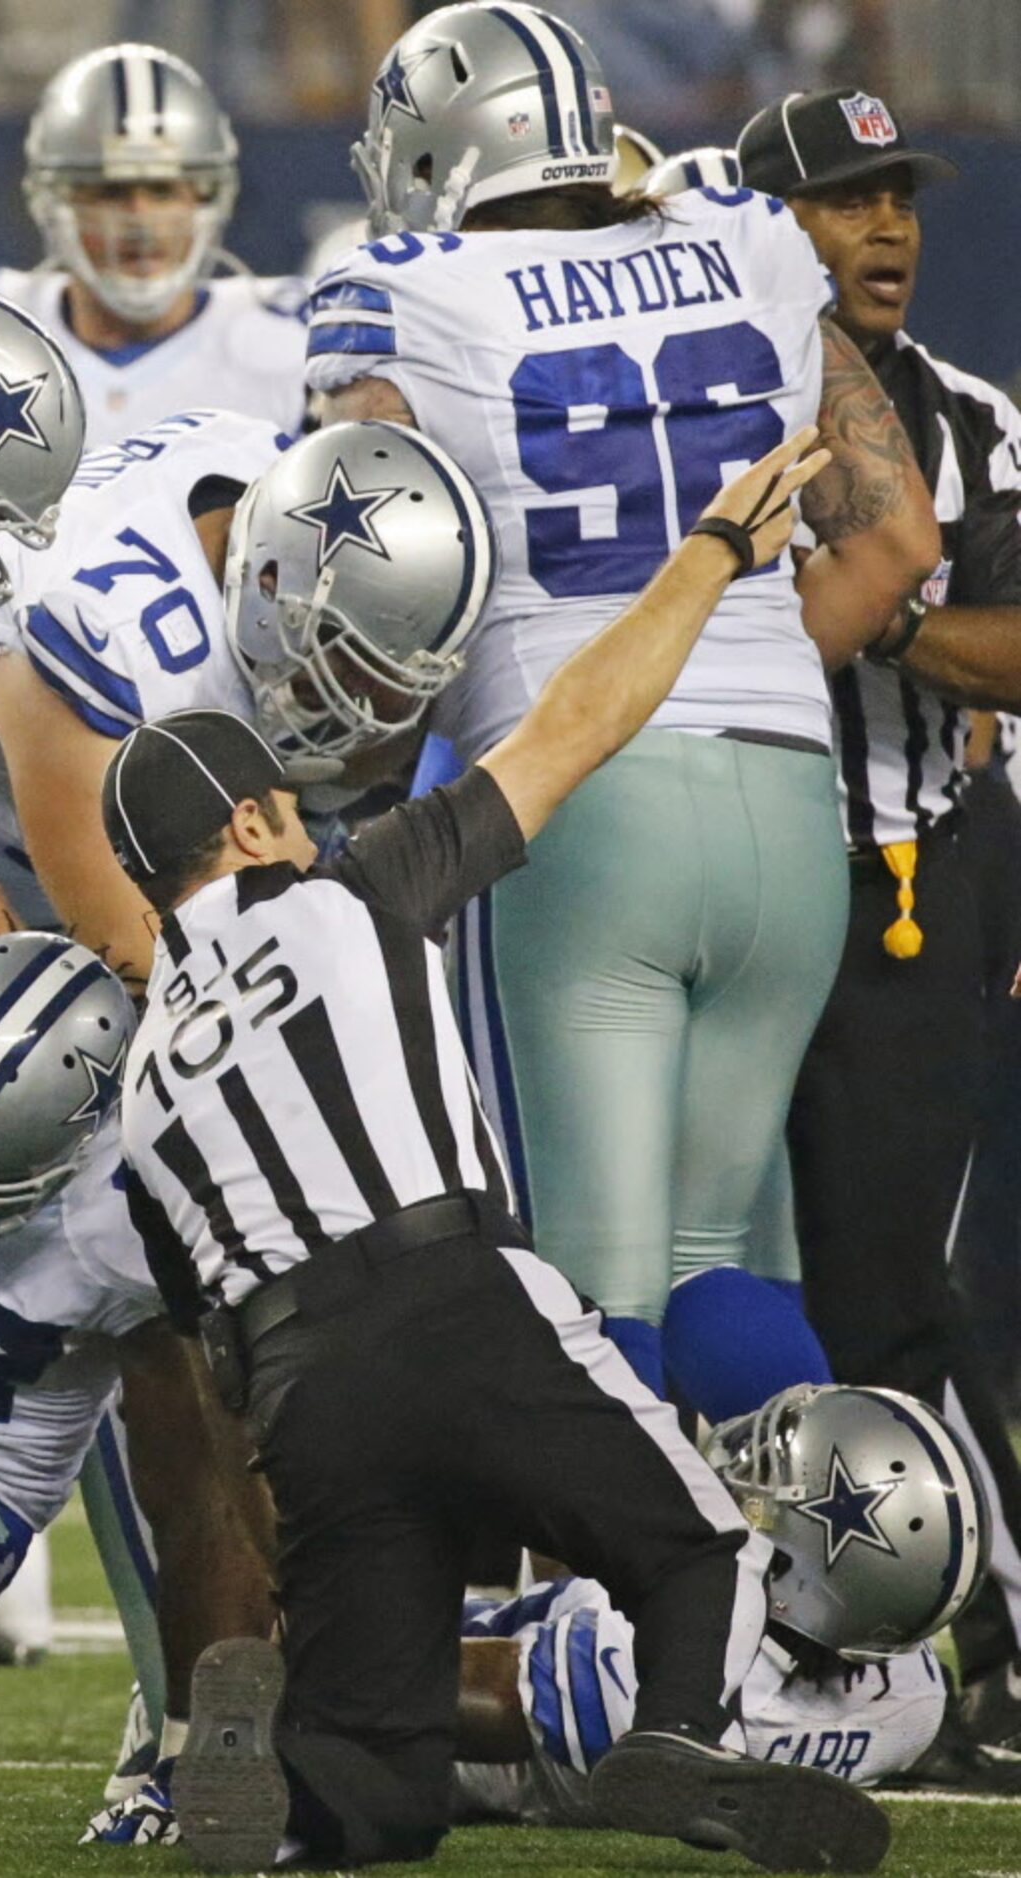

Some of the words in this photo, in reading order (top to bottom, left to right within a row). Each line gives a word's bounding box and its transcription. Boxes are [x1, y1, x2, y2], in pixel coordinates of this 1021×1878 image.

[852, 113, 895, 139] NFL
[505, 239, 743, 332] HAYDEN
[508, 320, 786, 599] 96
[72, 526, 211, 674] 70
[135, 935, 299, 1113] 105
